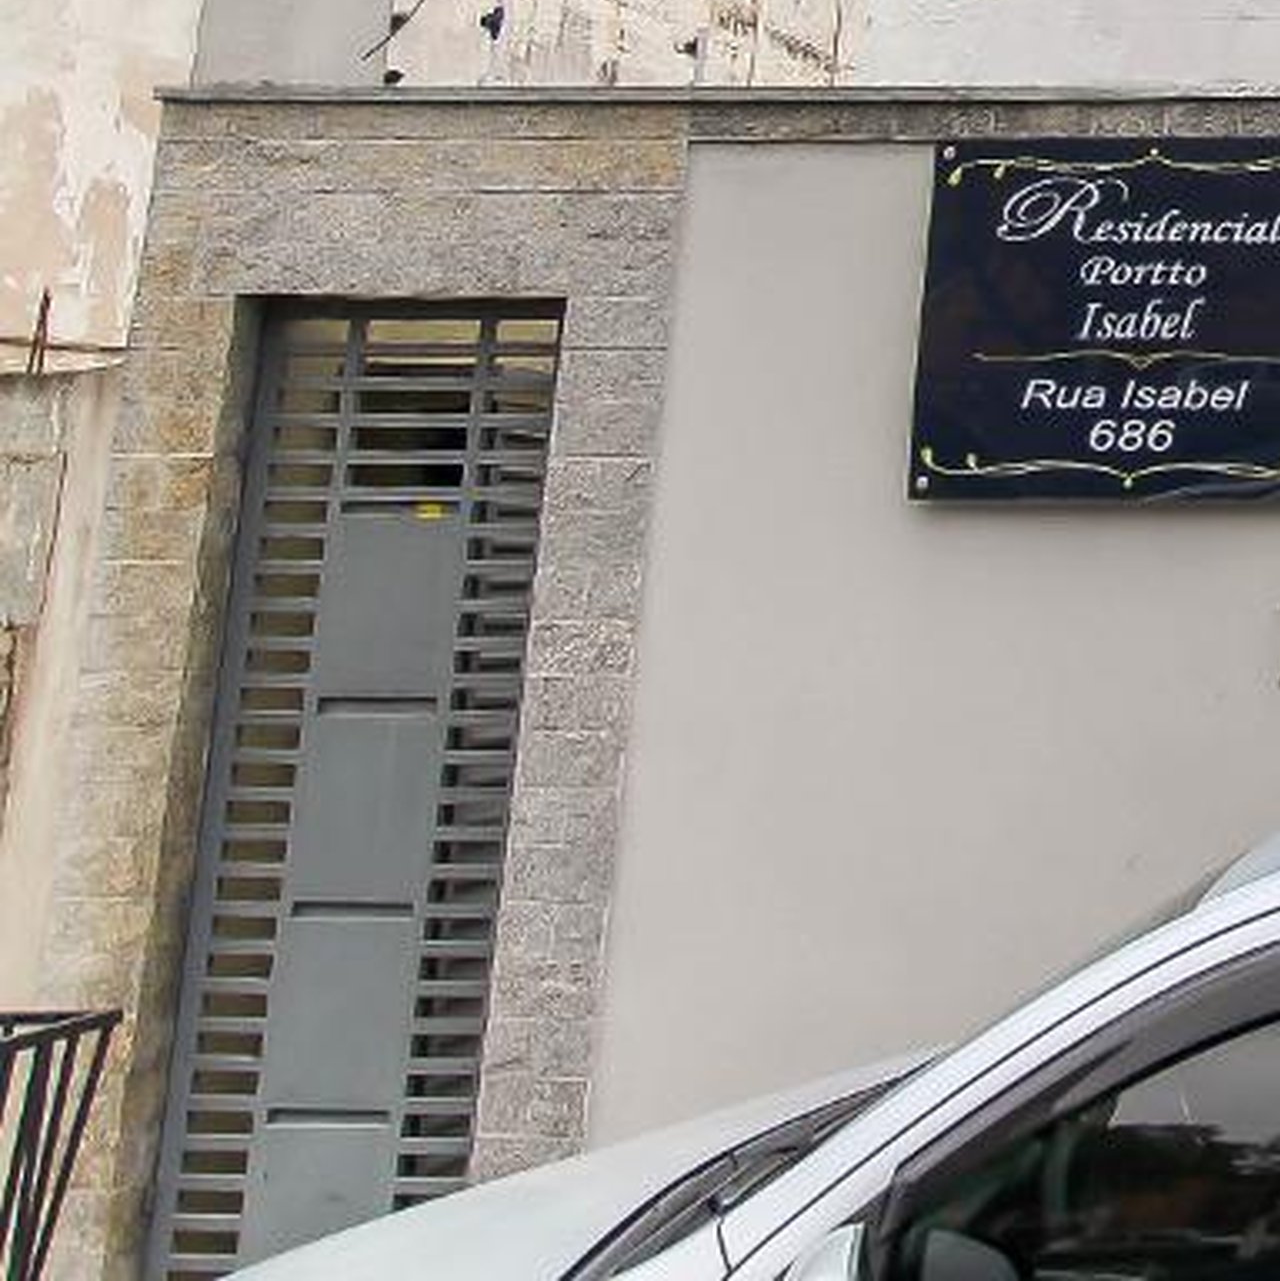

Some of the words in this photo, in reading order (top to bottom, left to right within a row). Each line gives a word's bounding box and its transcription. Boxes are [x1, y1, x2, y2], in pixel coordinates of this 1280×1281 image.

[1079, 254, 1208, 288] Portto
[1072, 295, 1206, 341] Isabel
[1020, 378, 1106, 411] Rua
[1121, 377, 1251, 412] Isabel
[1087, 419, 1176, 452] 686
